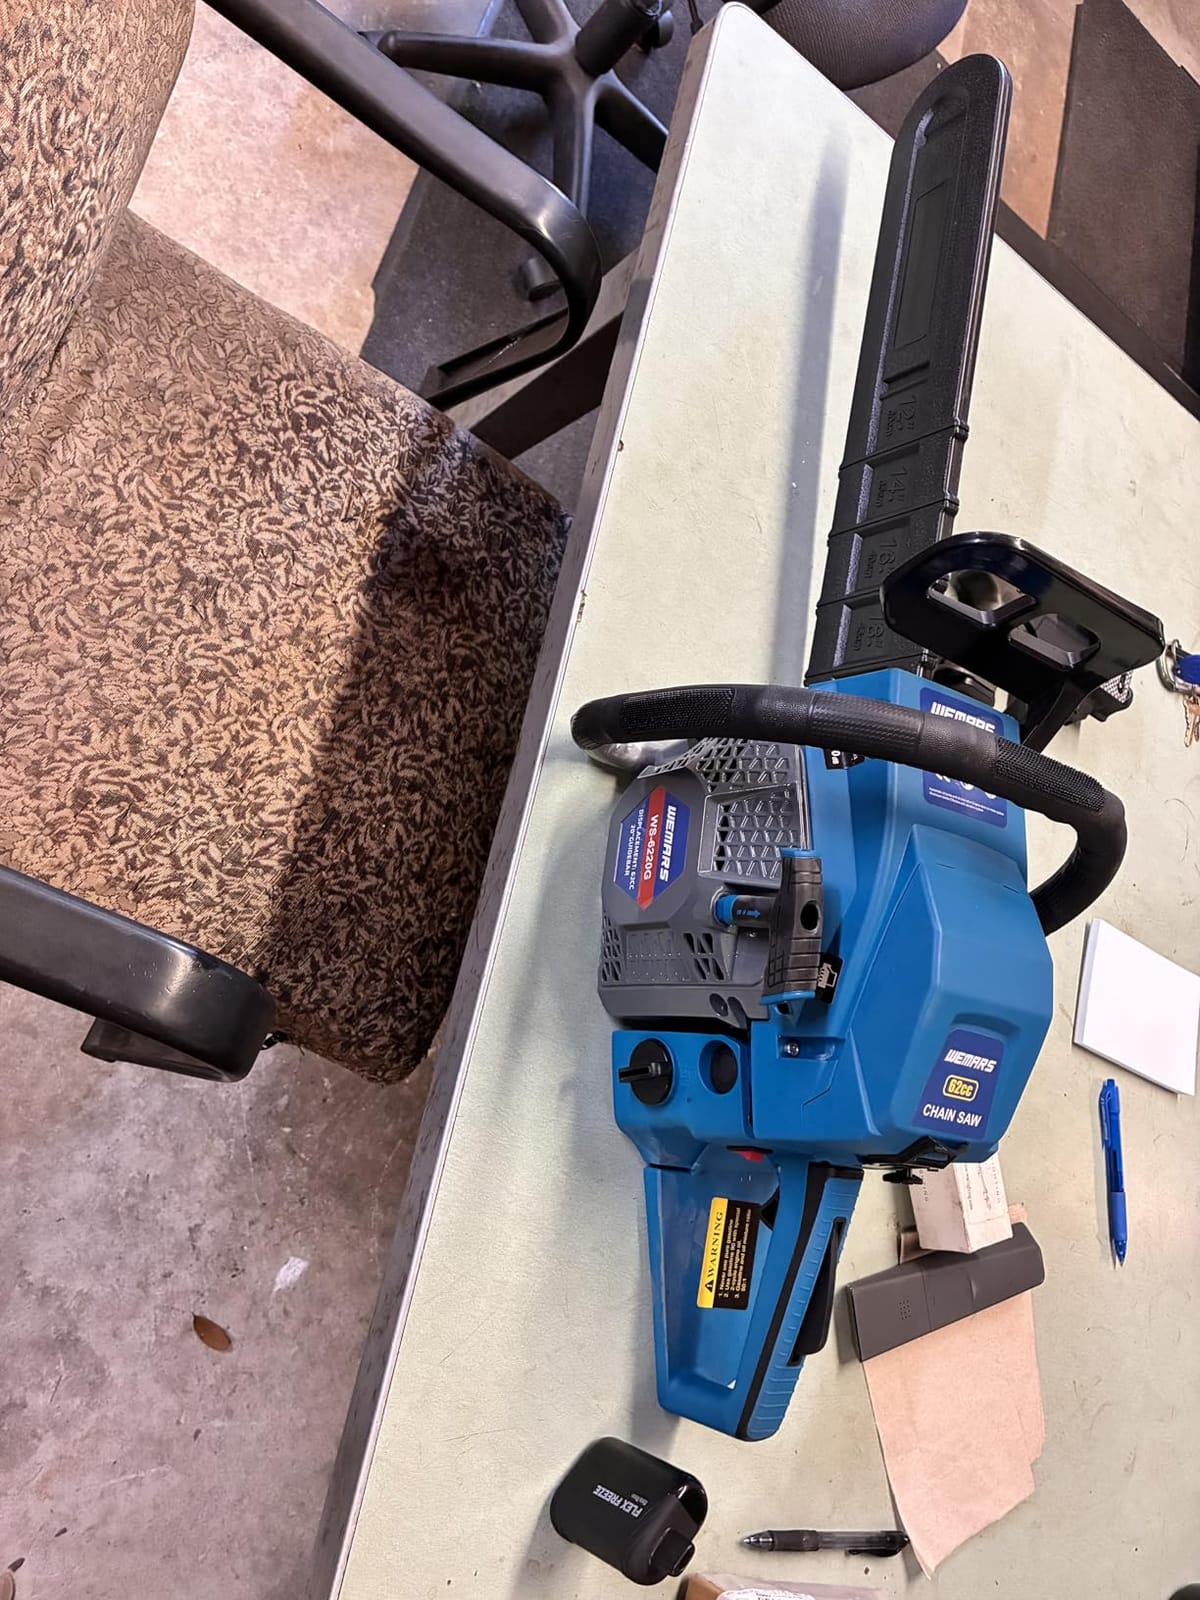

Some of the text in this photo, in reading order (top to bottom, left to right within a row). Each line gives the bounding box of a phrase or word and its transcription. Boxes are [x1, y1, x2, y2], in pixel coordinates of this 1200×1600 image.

[643, 814, 660, 881] WS-6220G
[659, 805, 677, 882] WEMARS
[944, 1049, 997, 1073] WEMARS
[922, 1103, 983, 1127] CHAIN SAW
[707, 1211, 722, 1277] WARNING
[592, 1485, 623, 1507] FREEZE
[620, 1498, 644, 1518] FLEX
